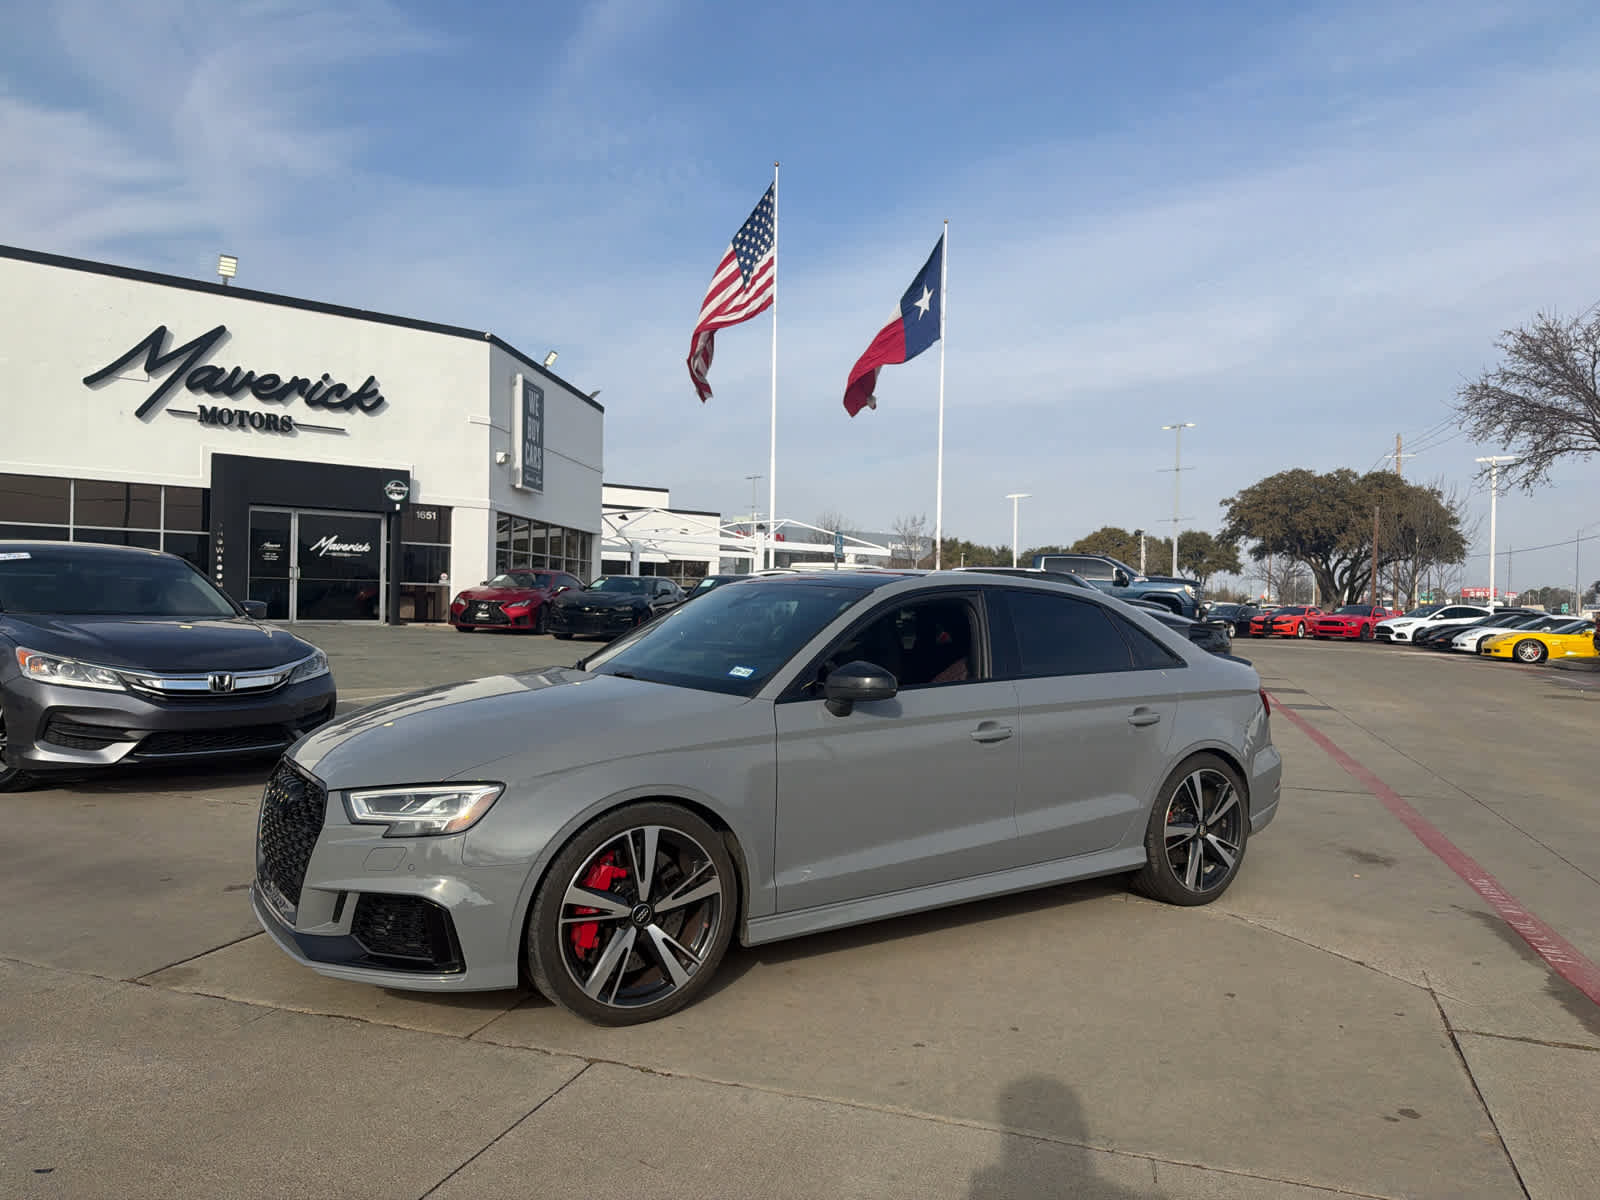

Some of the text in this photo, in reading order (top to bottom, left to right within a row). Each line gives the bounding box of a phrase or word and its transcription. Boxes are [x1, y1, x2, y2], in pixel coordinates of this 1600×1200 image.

[83, 325, 385, 418] Maverick
[528, 389, 539, 417] WE
[197, 404, 294, 433] MOTORS
[527, 415, 540, 445] BUY
[525, 440, 542, 470] CARS
[416, 511, 437, 521] 1651
[309, 535, 372, 557] Maverick
